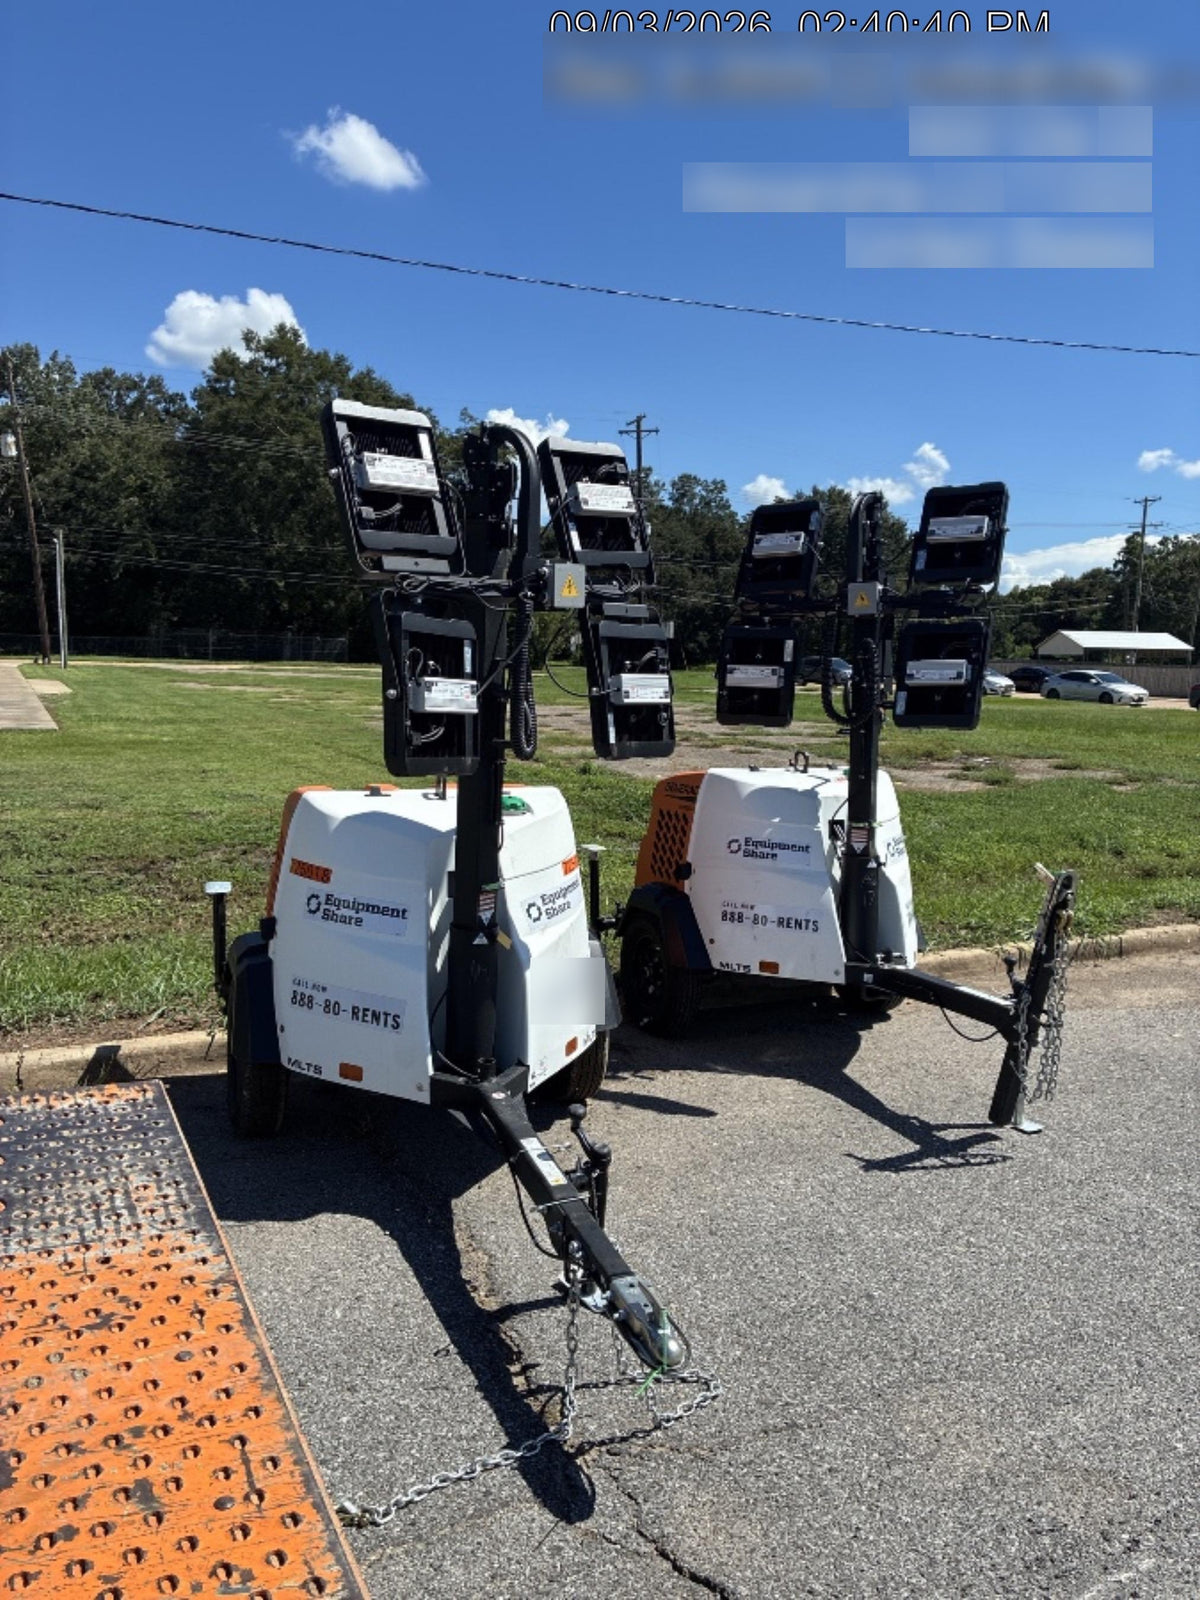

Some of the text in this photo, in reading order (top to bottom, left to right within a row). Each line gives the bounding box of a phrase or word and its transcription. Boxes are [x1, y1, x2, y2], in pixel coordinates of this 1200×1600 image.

[742, 847, 778, 861] Share
[744, 837, 810, 854] Equipment
[324, 894, 408, 919] Equipment
[321, 908, 363, 927] Share
[721, 909, 819, 933] 888-80-RENTS
[291, 990, 401, 1031] 888-80-RENTS
